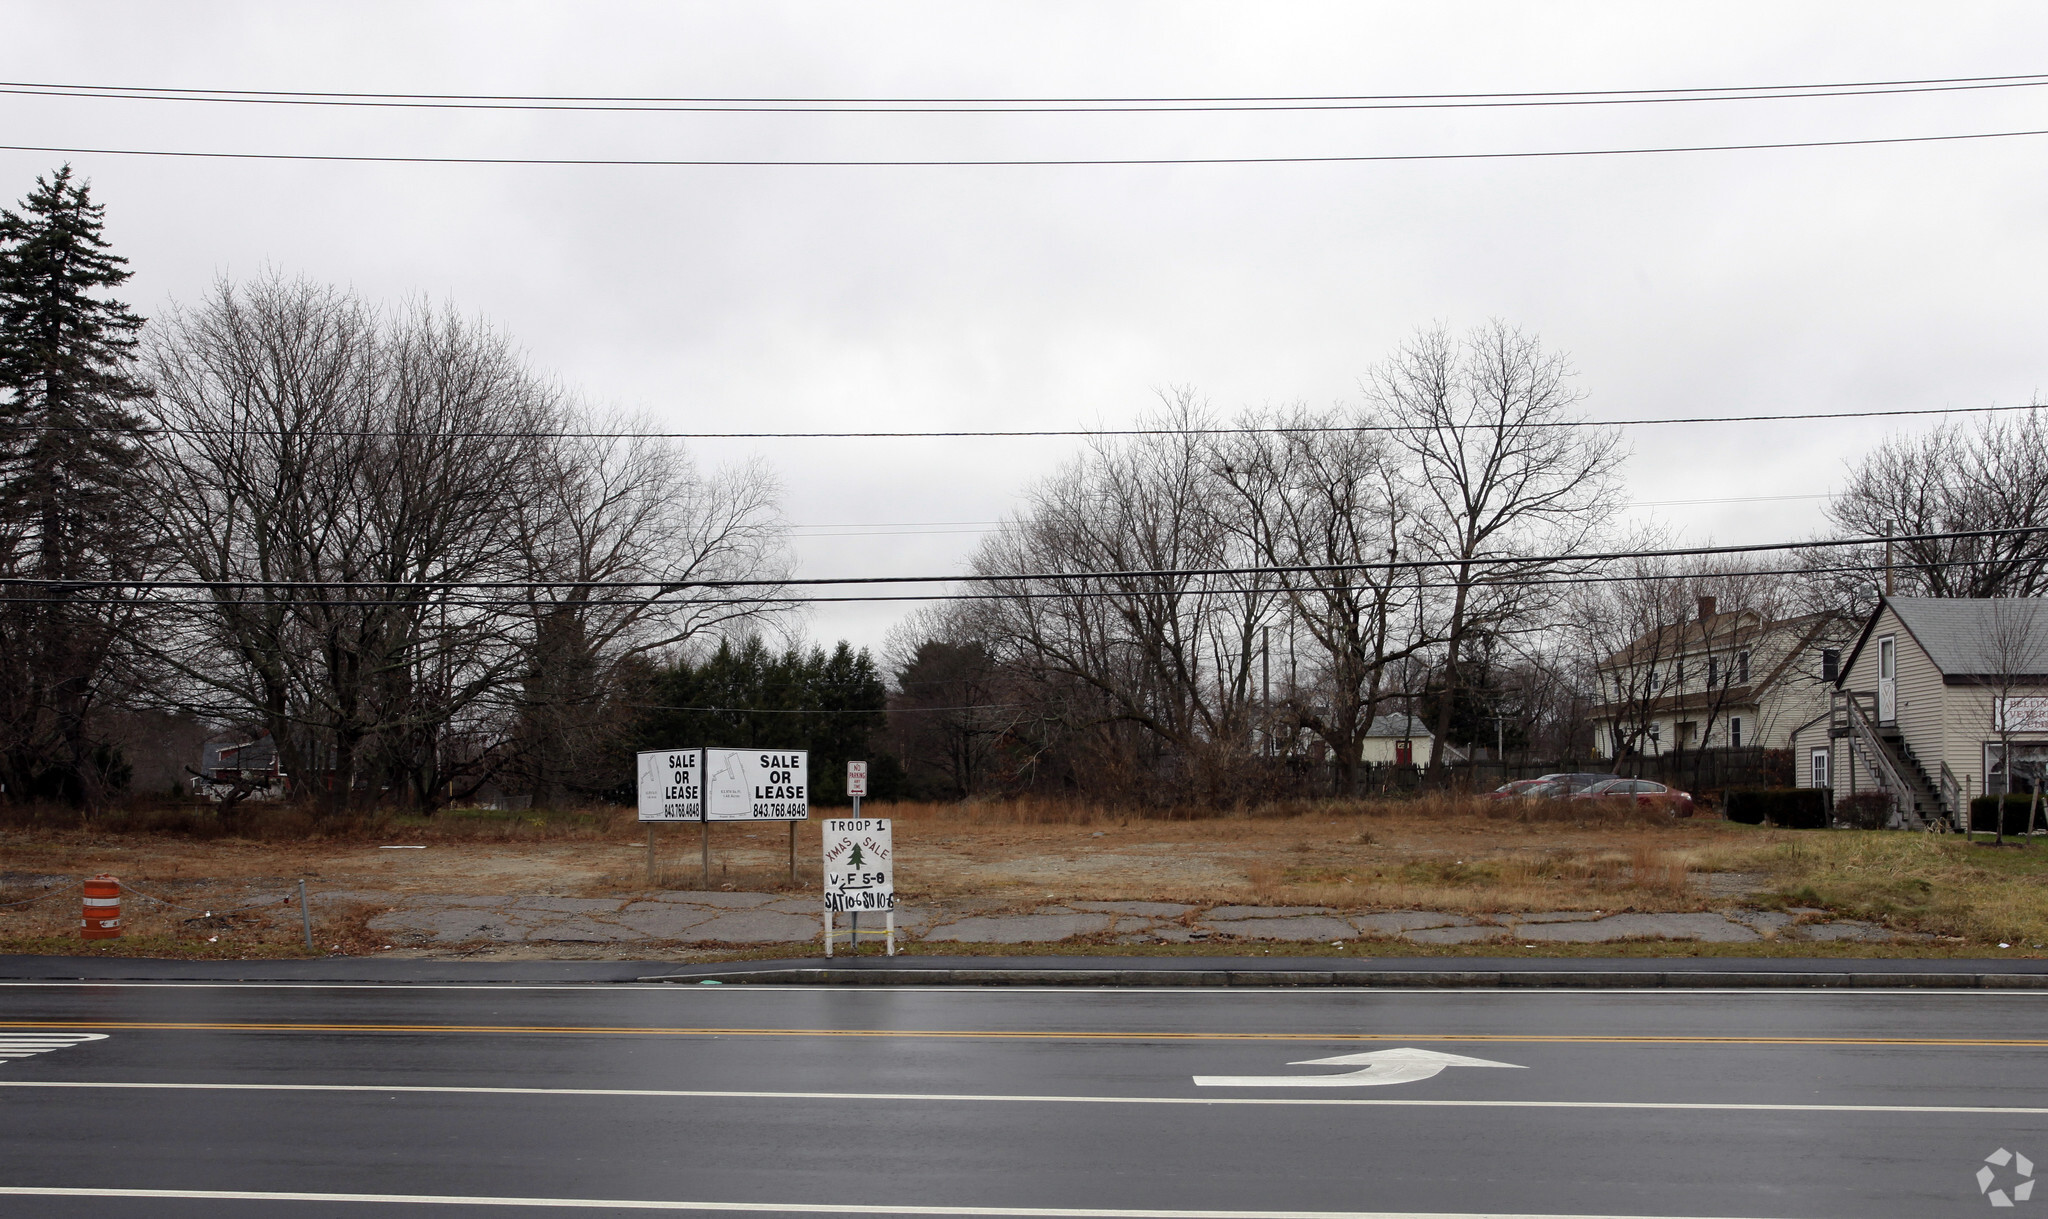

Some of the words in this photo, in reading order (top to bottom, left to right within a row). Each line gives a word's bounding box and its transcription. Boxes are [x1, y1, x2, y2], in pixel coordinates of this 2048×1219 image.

[669, 754, 696, 769] SALE
[760, 754, 800, 769] SALE
[674, 771, 690, 784] OR
[769, 770, 791, 784] OR
[665, 786, 699, 800] LEASE
[755, 786, 804, 799] LEASE
[664, 803, 700, 818] 843.768.4848
[753, 803, 806, 818] 843.768.4848
[831, 820, 871, 831] TROOP
[876, 819, 886, 831] 1
[825, 836, 852, 862] XMAS
[862, 836, 890, 860] SALE
[862, 872, 885, 884] 5-8
[825, 892, 845, 912] SAT
[862, 891, 875, 909] SU
